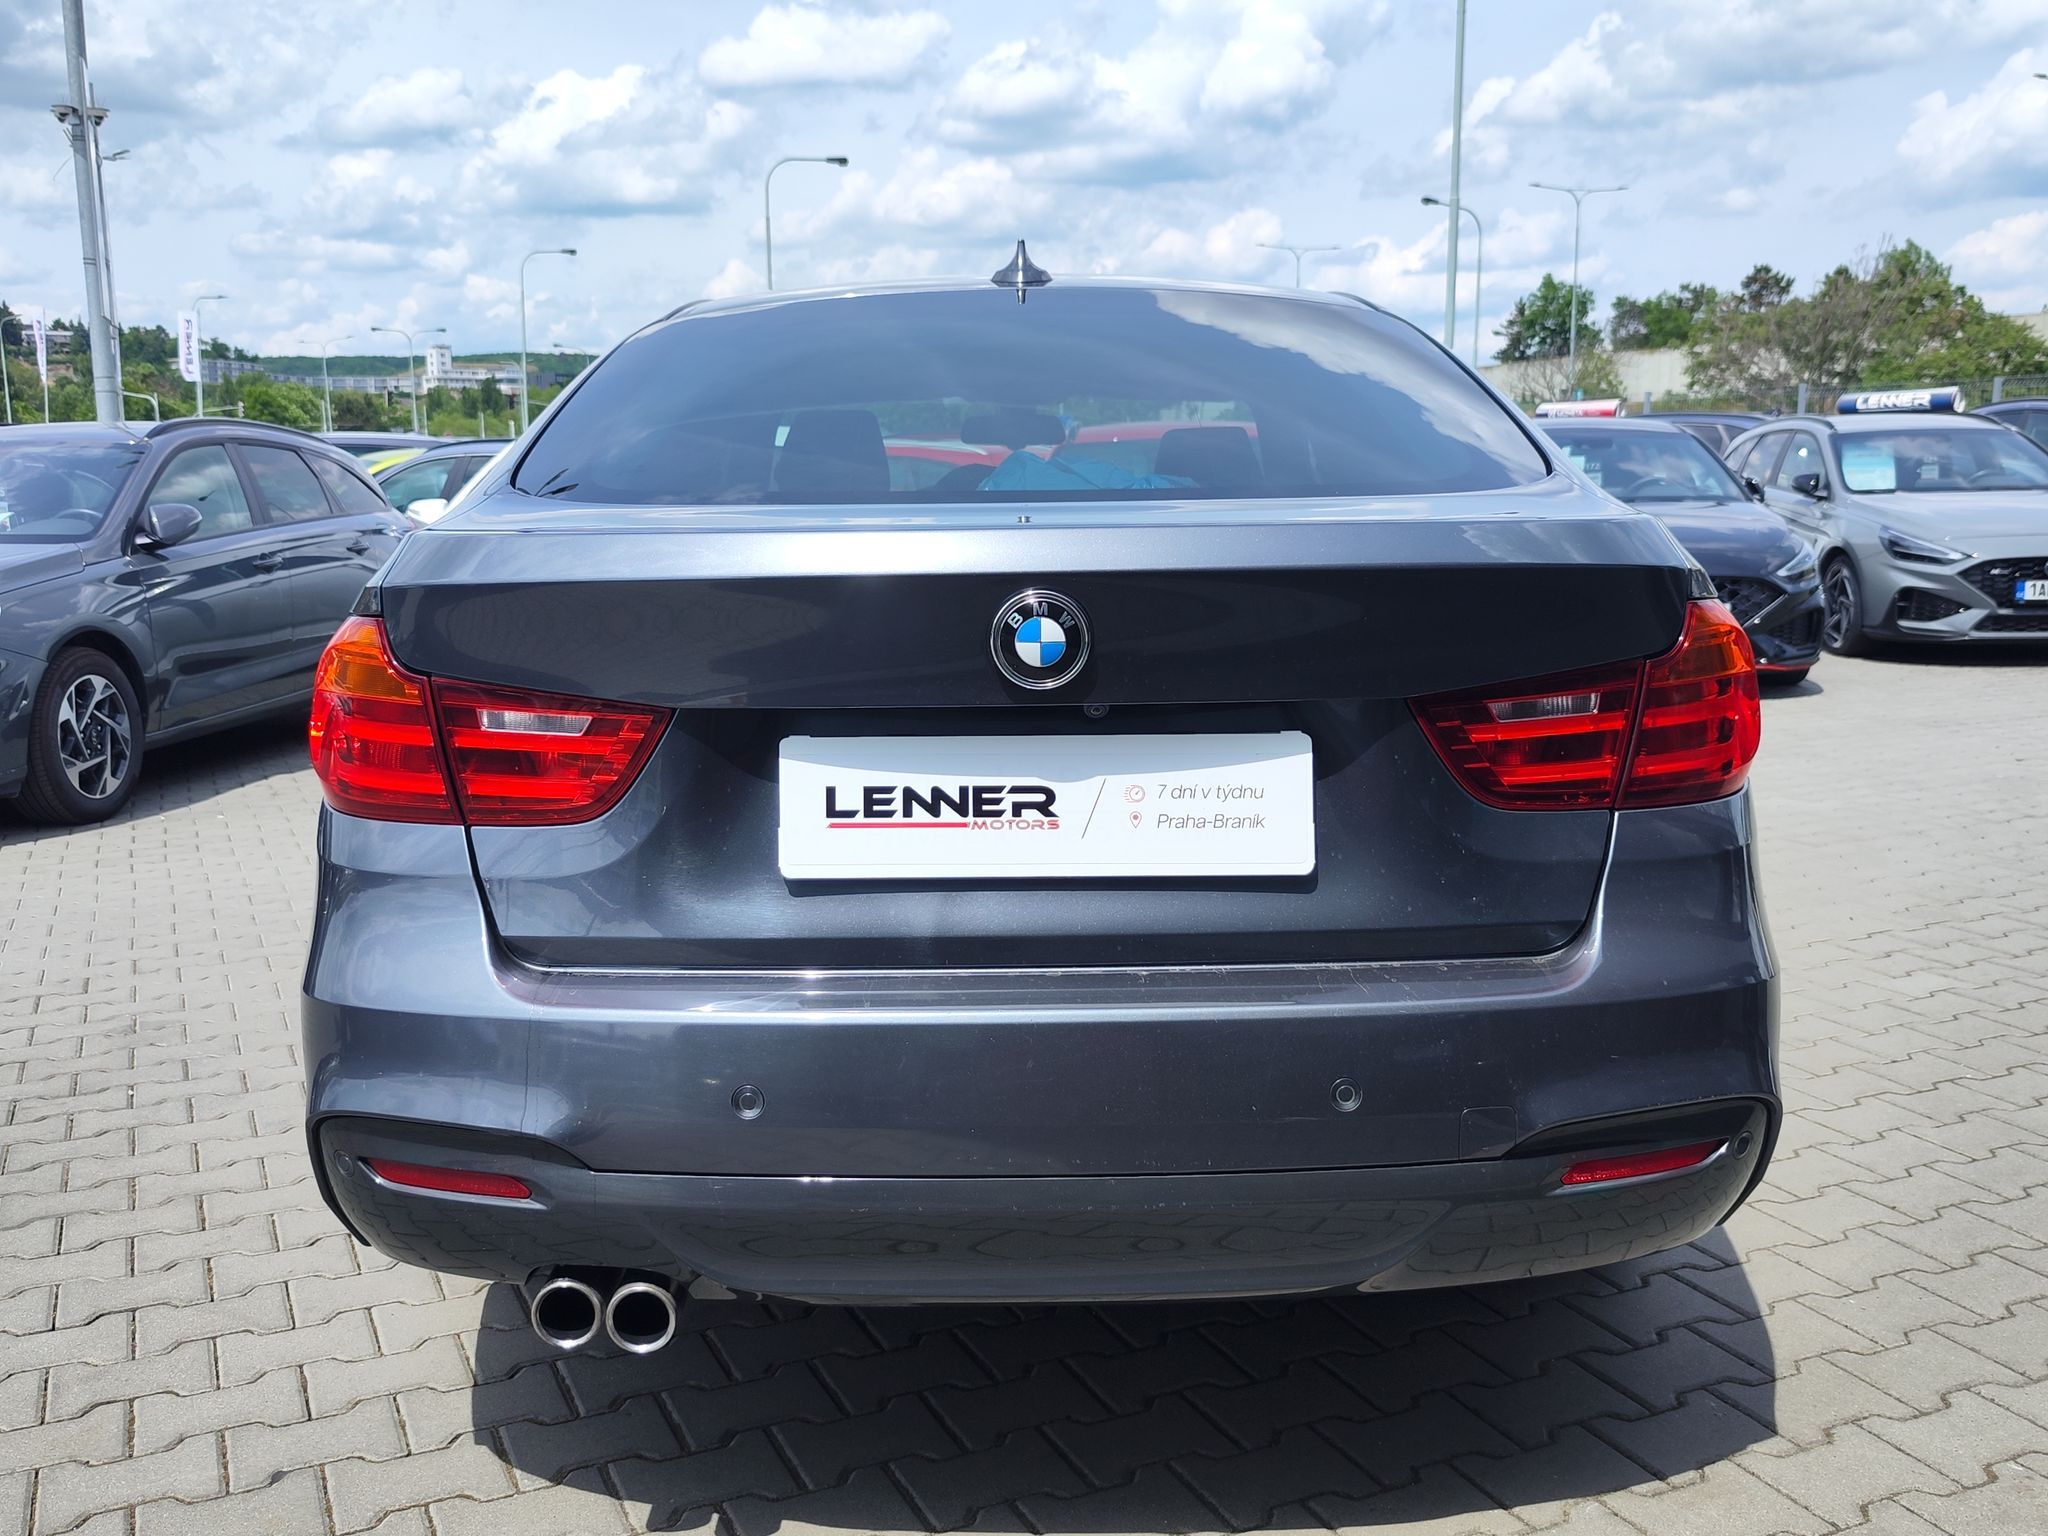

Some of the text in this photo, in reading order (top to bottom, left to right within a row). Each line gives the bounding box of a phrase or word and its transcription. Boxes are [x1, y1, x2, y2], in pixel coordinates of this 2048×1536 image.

[1856, 393, 1931, 409] LENNER
[2030, 583, 2048, 597] 1A
[1007, 602, 1075, 629] BMW
[1157, 784, 1265, 802] 7 dní v týdnu
[826, 785, 1060, 818] LENNER
[971, 820, 1060, 830] MOTORS
[1157, 813, 1266, 829] Praha-Braník
